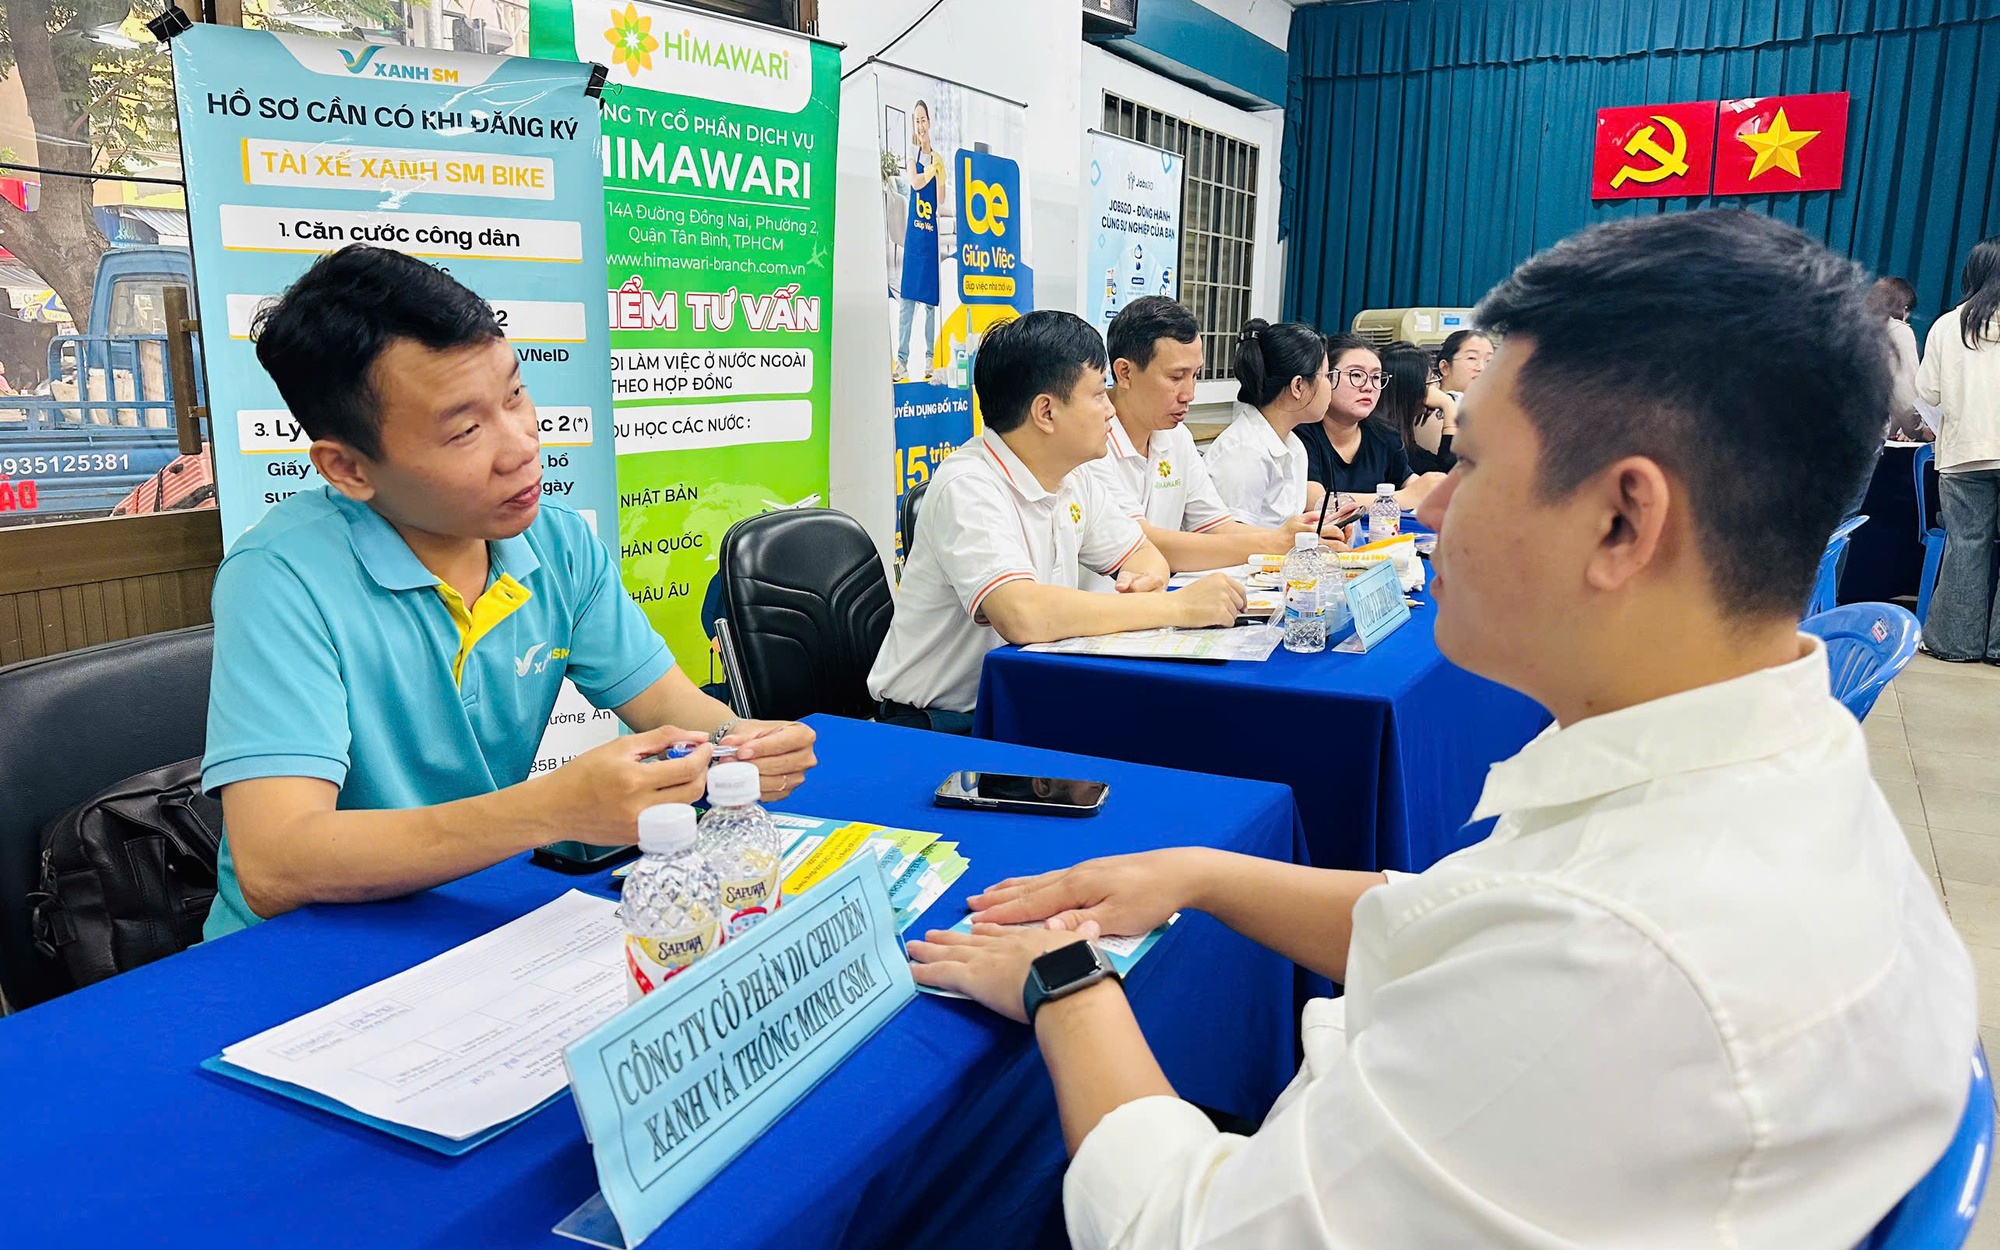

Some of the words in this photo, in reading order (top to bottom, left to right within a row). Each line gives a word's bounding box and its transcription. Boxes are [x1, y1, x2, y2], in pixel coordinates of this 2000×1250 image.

[374, 63, 429, 81] XANH
[432, 67, 459, 83] SM
[207, 88, 251, 117] HỒ
[258, 97, 299, 121] SƠ
[307, 96, 366, 126] CẦN
[374, 103, 414, 128] CÓ
[422, 109, 463, 130] KHI
[472, 110, 544, 138] ĐĂNG
[551, 116, 579, 141] KÝ
[599, 103, 631, 123] NG
[635, 107, 656, 127] TY
[662, 108, 689, 131] CỔ
[694, 115, 740, 140] PHẦN
[747, 125, 787, 147] DỊCH
[792, 131, 815, 153] VỤ
[260, 146, 307, 176] TÀI
[315, 149, 352, 178] XẾ
[360, 156, 438, 182] XANH
[445, 161, 484, 185] SM
[492, 166, 545, 188] BIKE
[915, 192, 932, 220] be
[964, 157, 1009, 236] be
[607, 201, 634, 218] 14A
[636, 204, 685, 226] Đường
[689, 208, 724, 229] Đồng
[728, 213, 752, 231] Nai,
[756, 215, 807, 236] Phường
[810, 220, 819, 236] 2,
[279, 222, 290, 237] 1.
[295, 220, 344, 242] Căn
[350, 221, 409, 243] cước
[415, 226, 473, 251] công
[482, 226, 520, 247] dân
[628, 226, 666, 246] Quận
[670, 229, 696, 246] Tân
[701, 231, 731, 249] Bình,
[735, 235, 784, 252] TPHCM
[606, 252, 806, 275] www.himawari-branch.com.vn
[962, 243, 990, 272] Giúp
[993, 246, 1015, 274] Việc
[685, 285, 738, 332] TƯ
[741, 284, 820, 332] VẤN
[629, 352, 660, 370] LÀM
[664, 353, 700, 372] VIỆC
[704, 352, 714, 369] Ở
[719, 350, 756, 368] NƯỚC
[760, 352, 806, 368] NGOÀI
[653, 376, 688, 395] HỢP
[692, 373, 732, 391] ĐỒNG
[894, 400, 914, 418] UYỂN
[916, 403, 936, 418] DỤNG
[952, 398, 968, 412] TÁC
[254, 423, 269, 436] 3.
[635, 421, 668, 439] HỌC
[672, 417, 704, 434] CÁC
[708, 414, 744, 432] NƯỚC
[0, 453, 130, 476] 935125381
[267, 460, 311, 480] Giấy
[542, 480, 574, 496] gày
[620, 488, 660, 510] NHẬT
[665, 484, 698, 502] BẢN
[621, 540, 652, 559] HÀN
[657, 531, 702, 554] QUỐC
[629, 586, 664, 604] HÂU
[668, 582, 690, 598] ÂU
[550, 711, 586, 725] ường
[617, 1039, 683, 1106] CÔNG
[679, 1007, 712, 1062] TY
[710, 978, 741, 1040] CỔ
[738, 953, 790, 1020] PHẦN
[785, 945, 808, 985] DI
[806, 895, 868, 968] CHUYỂN
[644, 1090, 710, 1162] XANH
[733, 1022, 800, 1090] THÔNG
[796, 988, 844, 1042] MINH
[839, 954, 878, 1005] GSM
